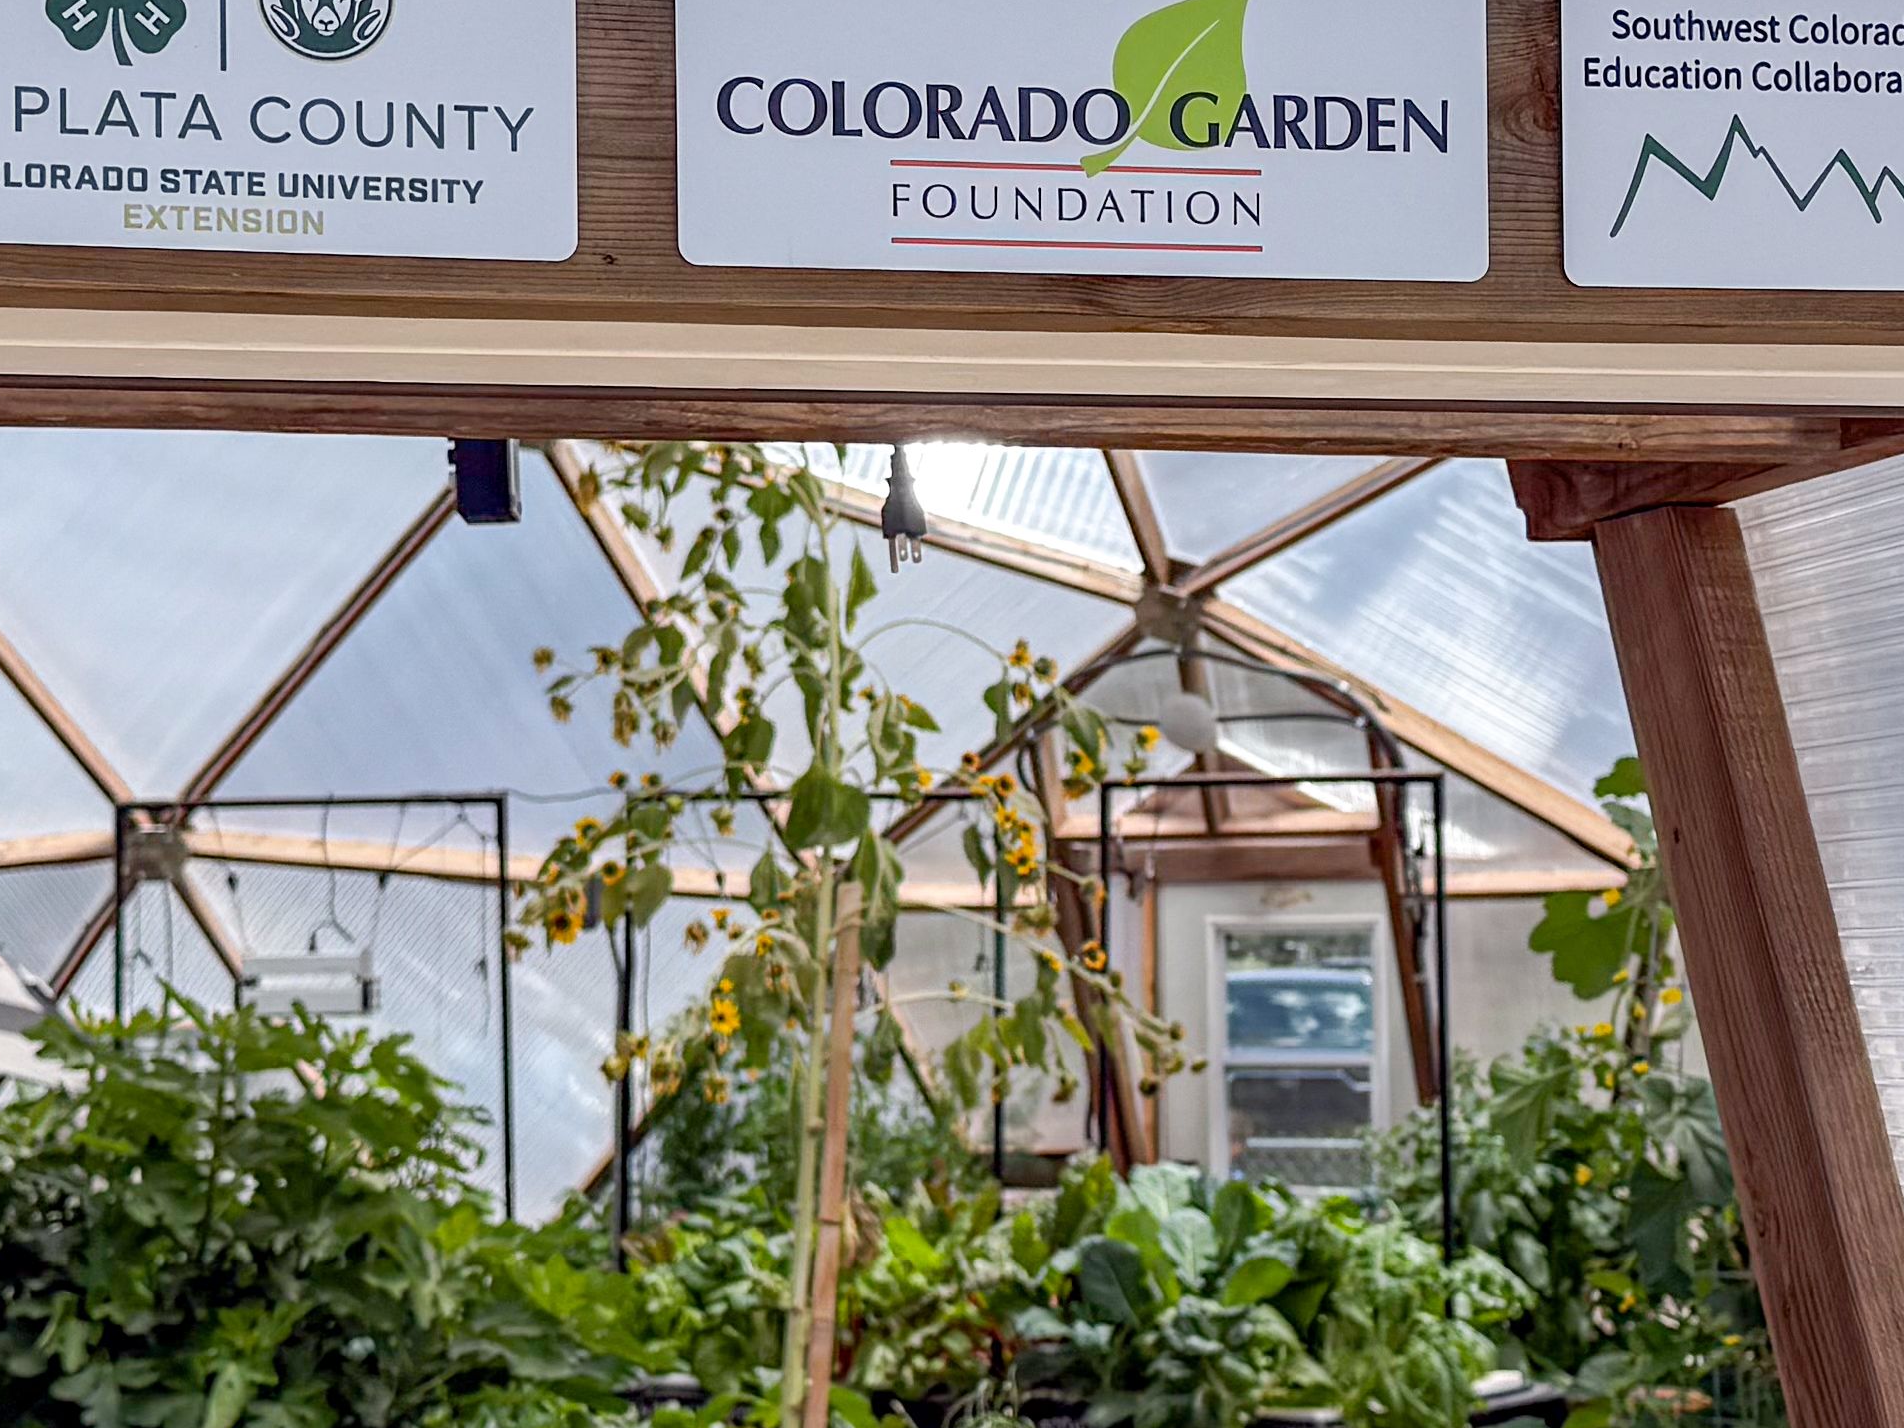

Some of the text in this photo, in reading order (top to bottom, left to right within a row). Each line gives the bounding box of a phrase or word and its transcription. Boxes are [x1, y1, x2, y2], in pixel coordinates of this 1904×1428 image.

[1612, 10, 1780, 43] Southwest
[1585, 56, 1741, 90] Education
[15, 86, 222, 140] PLATA
[250, 97, 533, 152] COUNTY
[717, 77, 1447, 153] COLORADO GARDEN
[161, 169, 265, 196] STATE
[279, 173, 483, 204] UNIVERSITY
[123, 204, 325, 236] EXTENSION
[893, 184, 1259, 226] FOUNDATION
